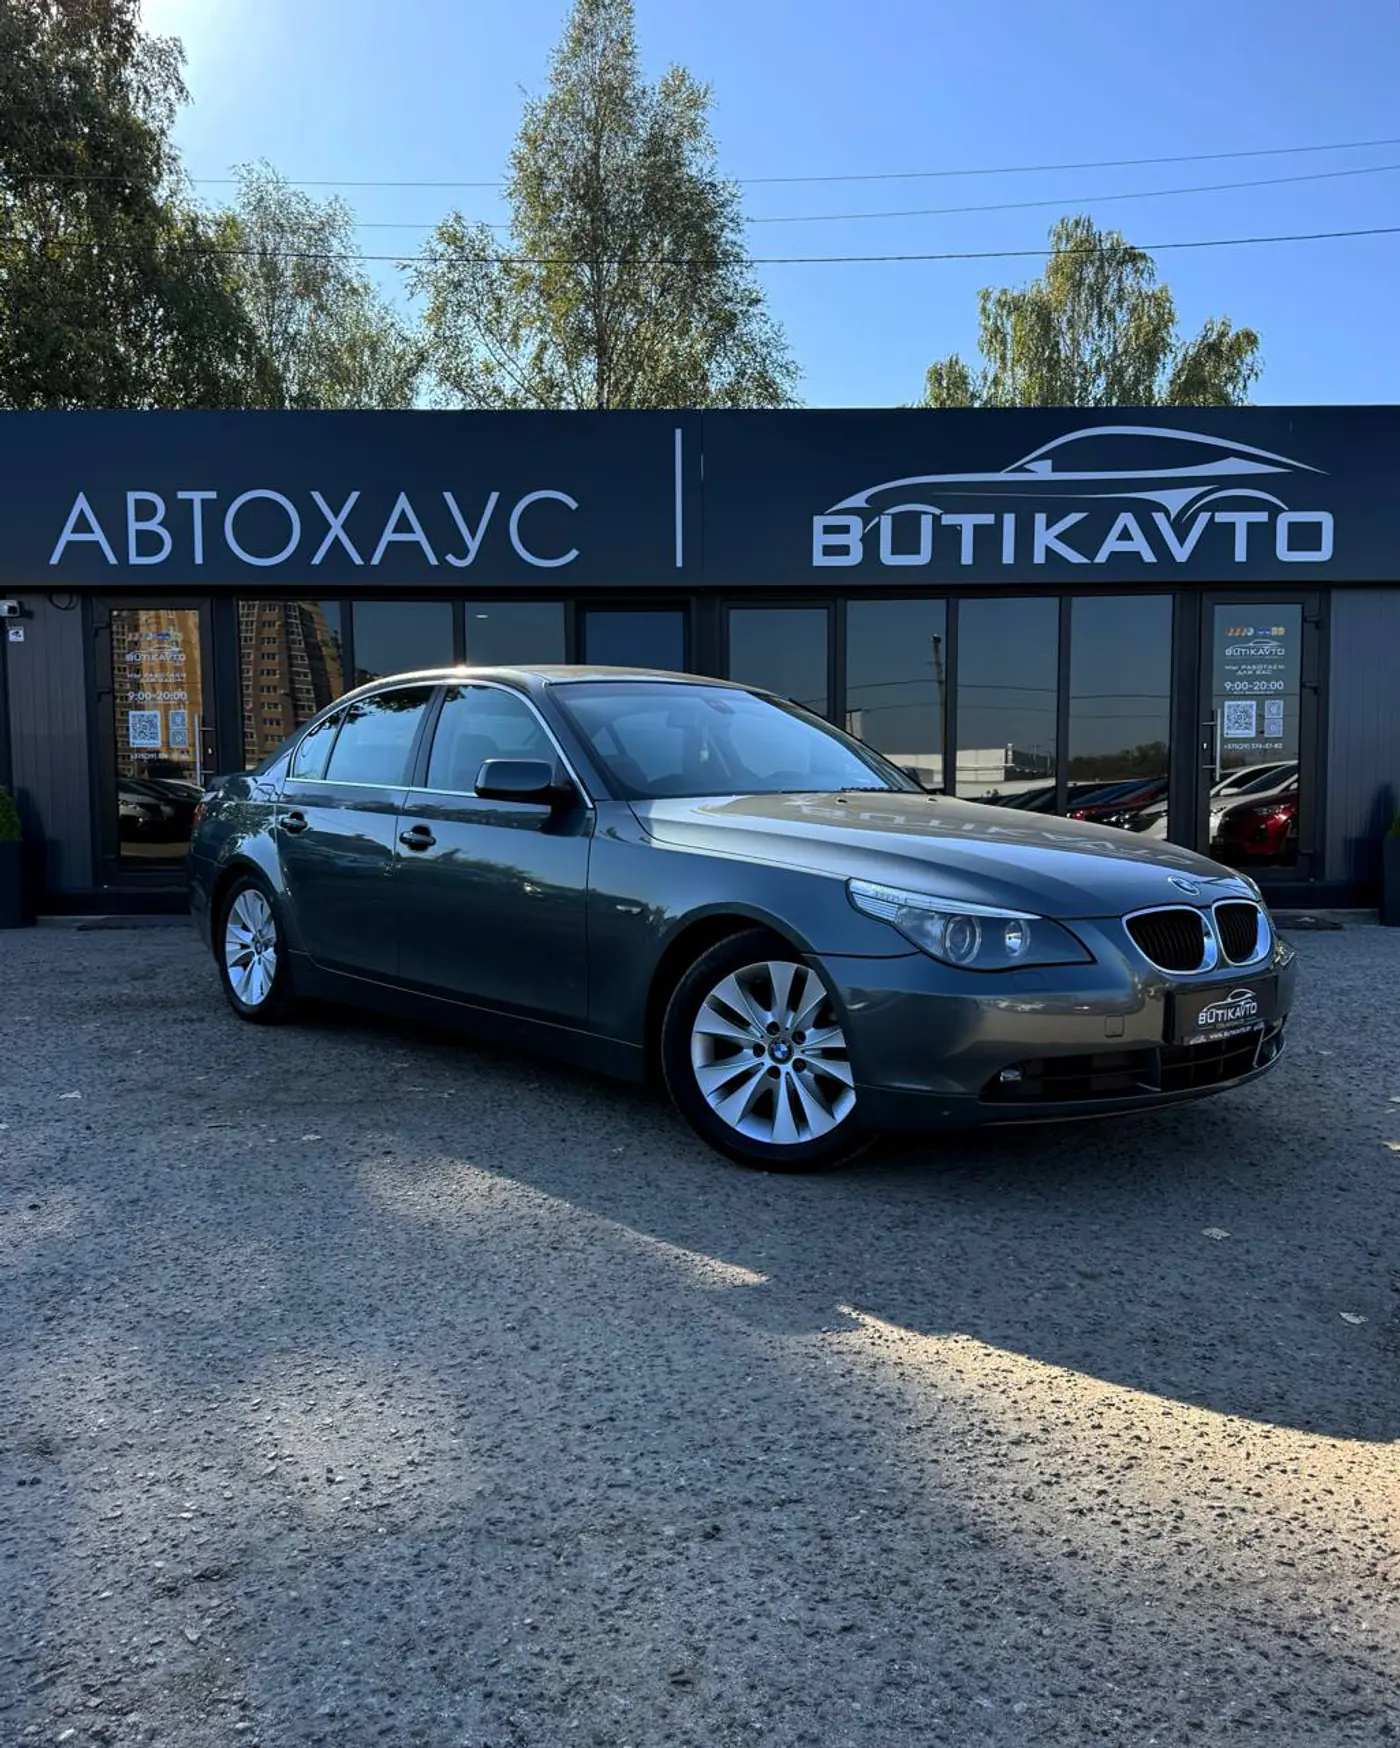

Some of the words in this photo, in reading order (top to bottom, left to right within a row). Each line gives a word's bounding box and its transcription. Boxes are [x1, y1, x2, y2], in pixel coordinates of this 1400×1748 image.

[49, 488, 580, 567] АВТОХАУС
[812, 510, 1335, 567] BUTIKAVTO
[127, 691, 187, 701] 9:00-20:00
[1224, 680, 1284, 690] 9:00-20:00
[1198, 1002, 1257, 1024] BUTIKAVTO
